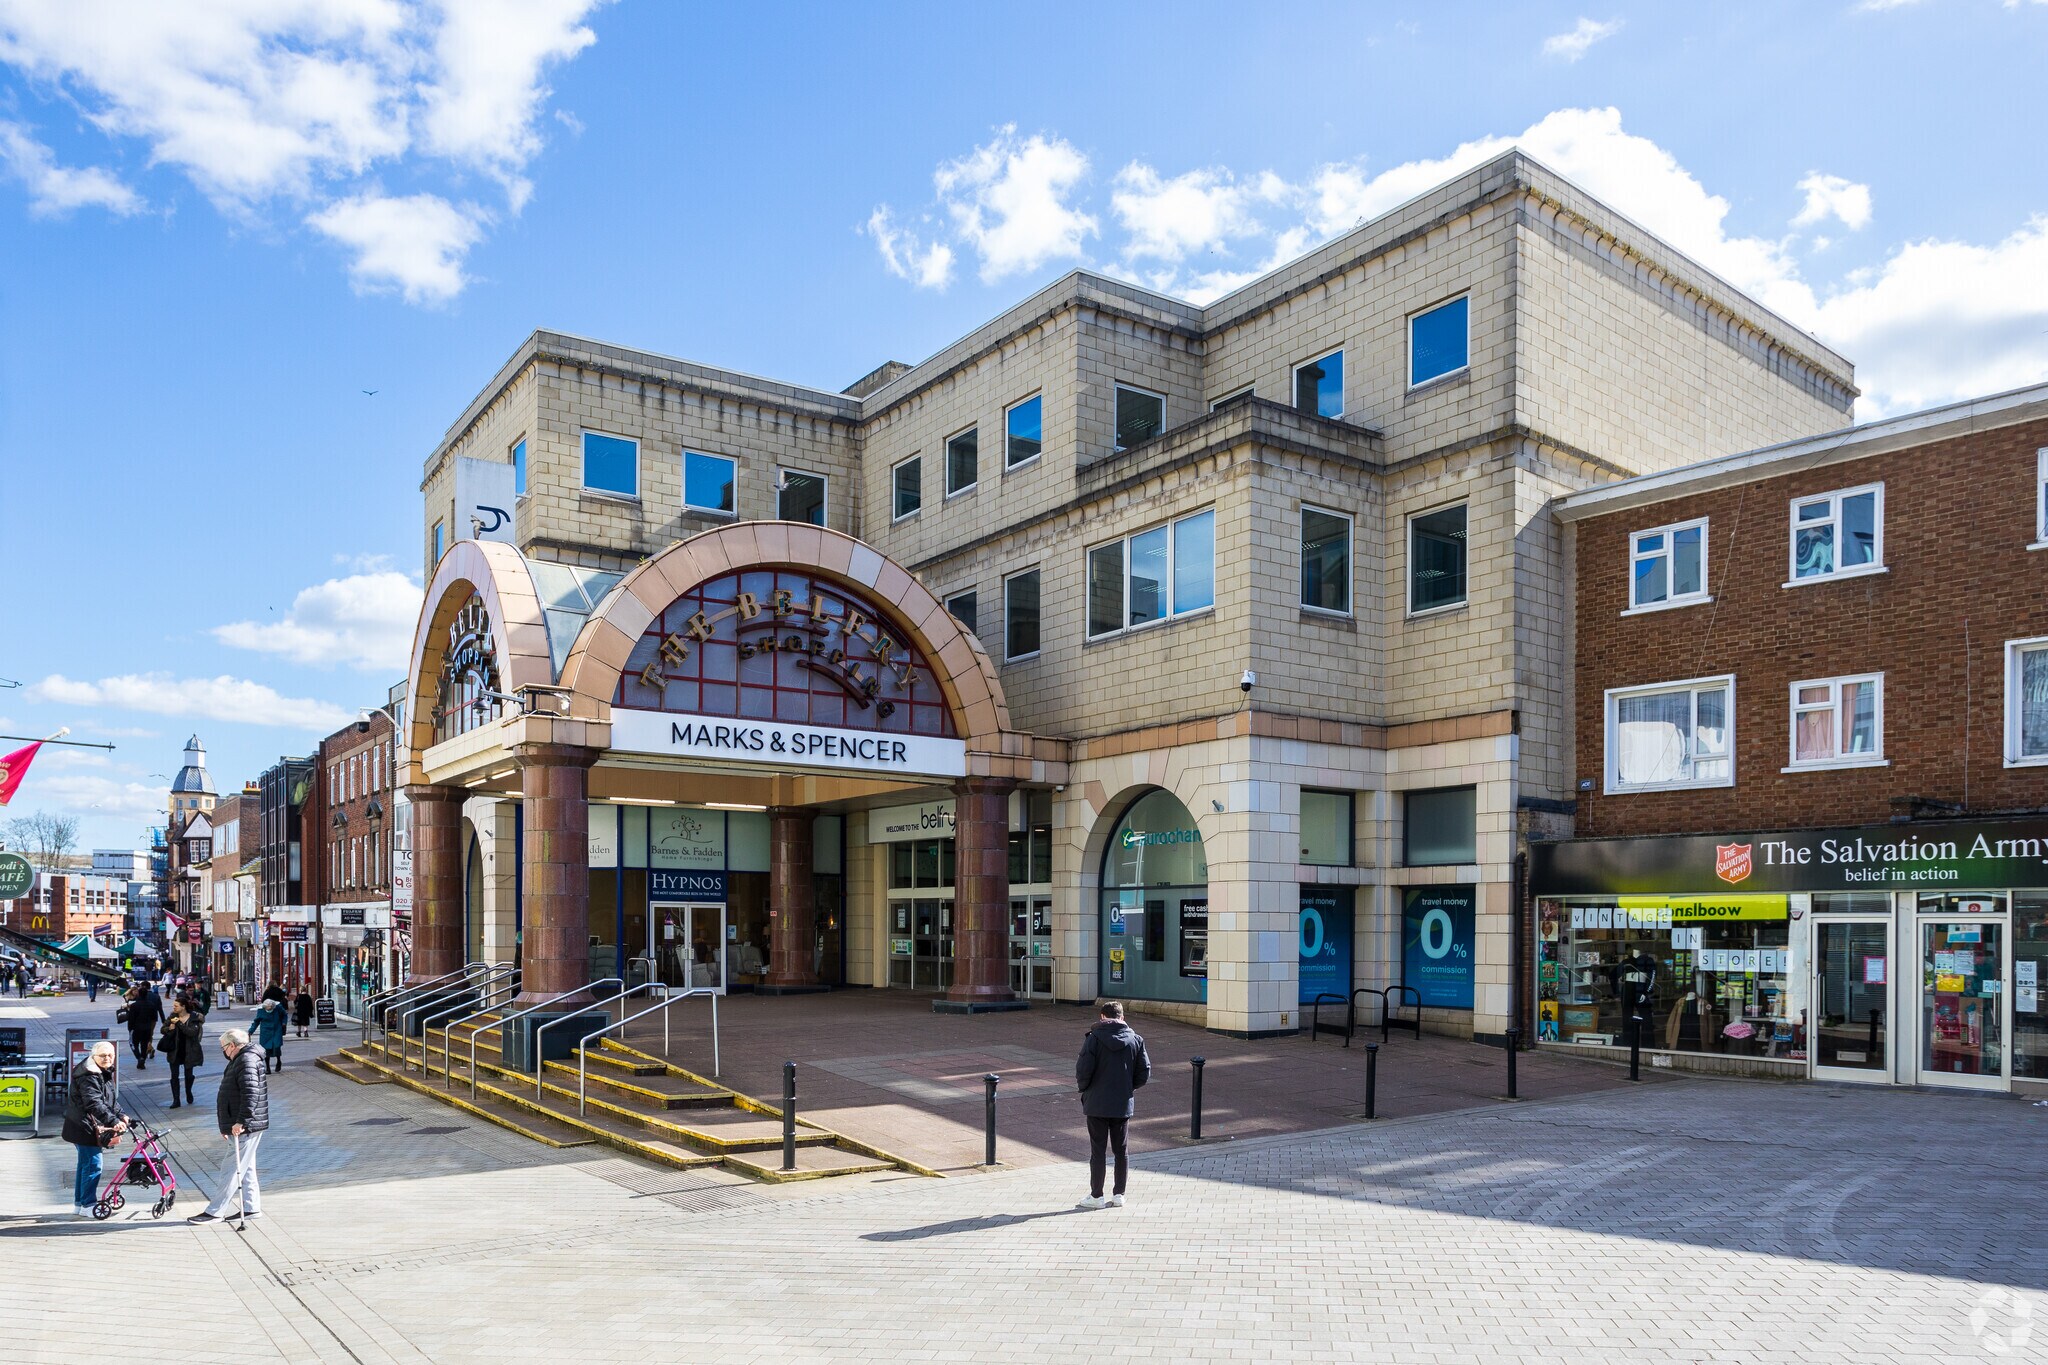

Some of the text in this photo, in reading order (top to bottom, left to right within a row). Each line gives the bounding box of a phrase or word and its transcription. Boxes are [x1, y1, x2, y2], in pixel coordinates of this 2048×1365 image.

[640, 589, 921, 692] THE BELFRY
[671, 721, 907, 763] MARKS & SPENCER
[920, 805, 956, 832] belfry
[886, 823, 920, 833] WELCOME TO THE
[651, 845, 724, 857] Barnes & Fadden
[1723, 847, 1737, 860] THE
[1760, 840, 1812, 866] The
[1820, 834, 1959, 864] Salvation
[1718, 849, 1751, 874] SALVATION
[1728, 861, 1748, 879] ARMY
[1844, 865, 1959, 882] belief in action
[652, 872, 723, 890] HYPNOS
[1183, 904, 1196, 912] free
[1315, 897, 1337, 907] money
[1421, 898, 1468, 907] travel money
[1677, 933, 1698, 944] IN
[1702, 953, 1787, 968] STORE!
[1421, 966, 1467, 974] commission
[1984, 981, 2001, 992] PUH
[0, 1099, 30, 1108] OPEN
